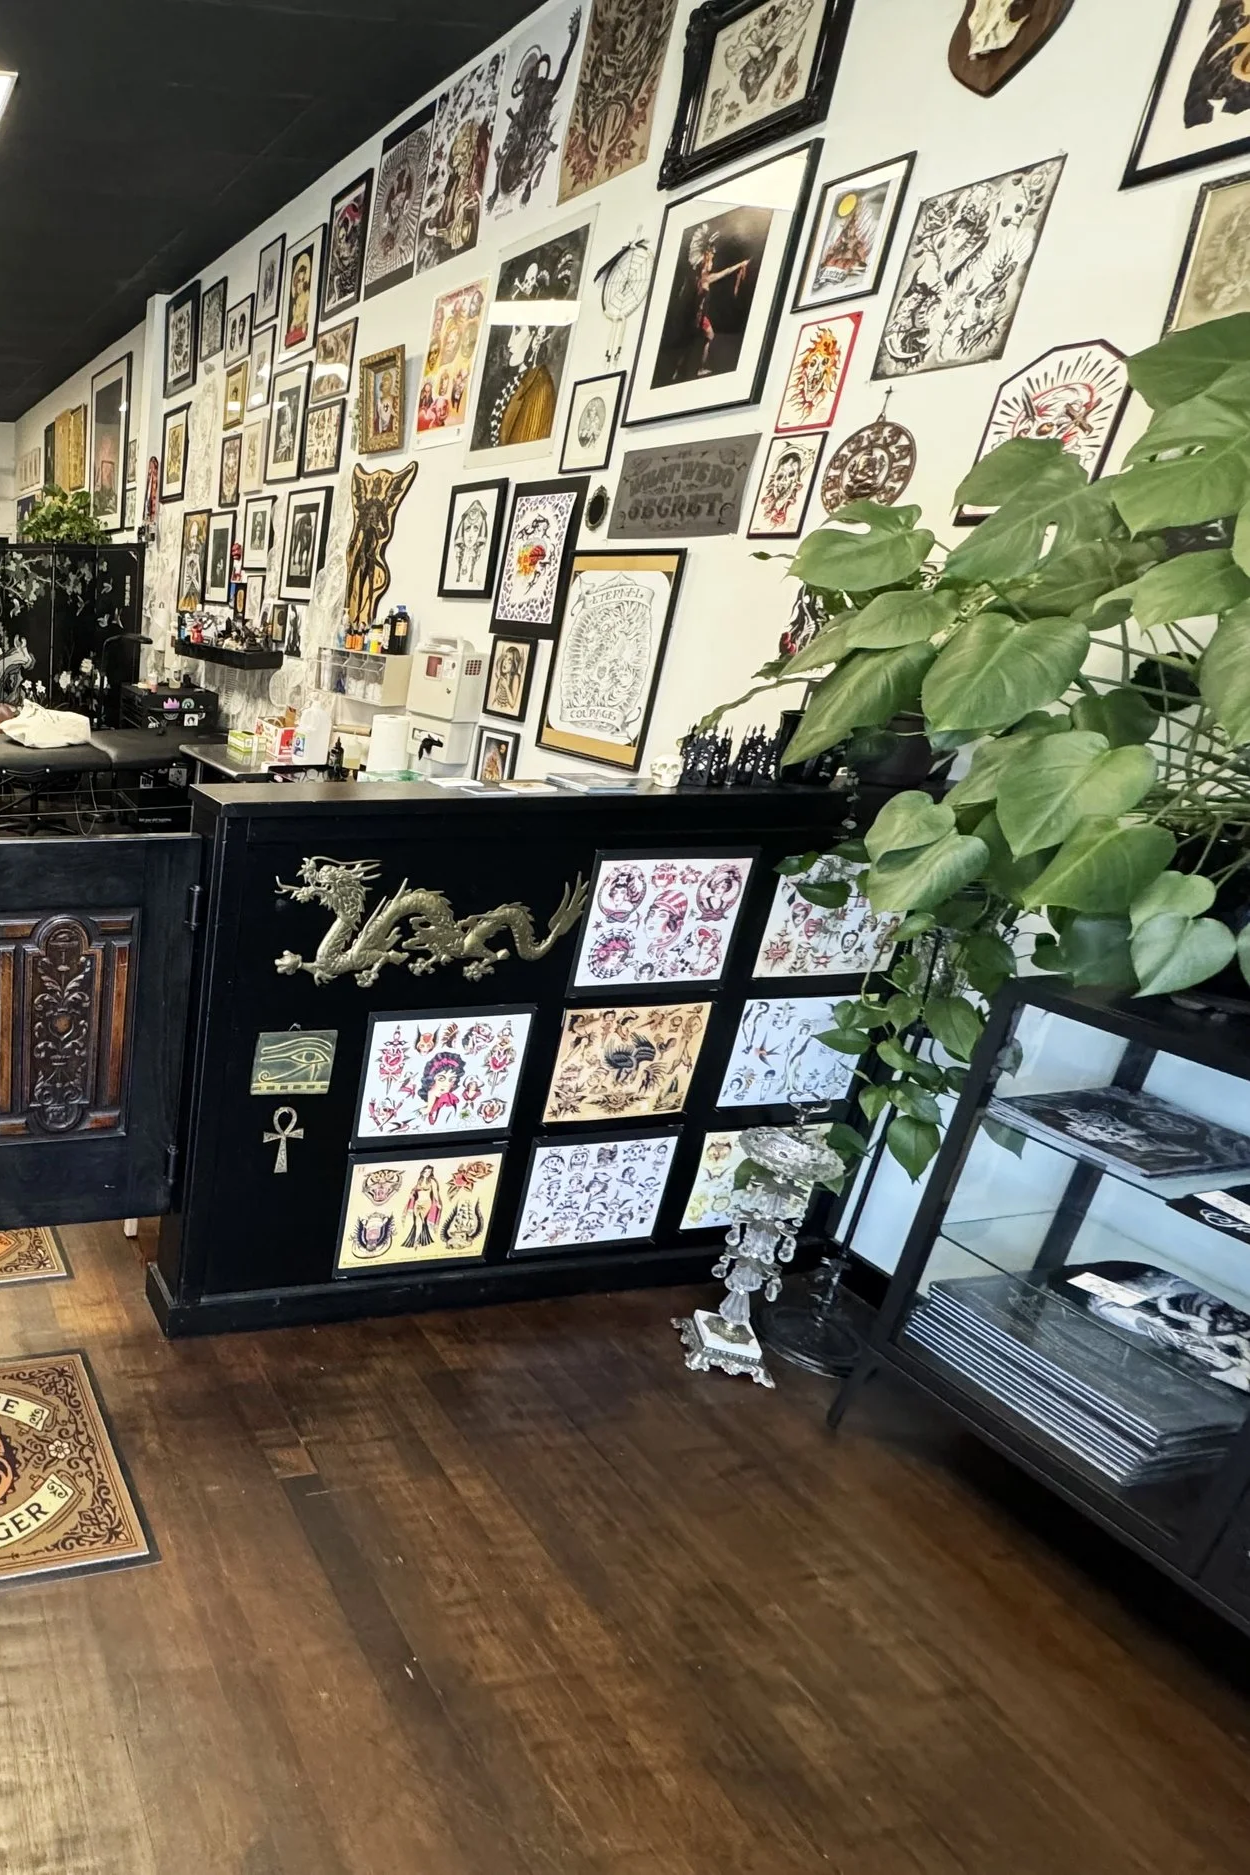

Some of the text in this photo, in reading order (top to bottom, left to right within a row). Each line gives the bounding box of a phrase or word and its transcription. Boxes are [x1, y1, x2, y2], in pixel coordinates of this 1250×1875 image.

[630, 461, 735, 497] WHAT WE DO
[628, 493, 723, 521] SECRET
[569, 708, 617, 721] COURAGE
